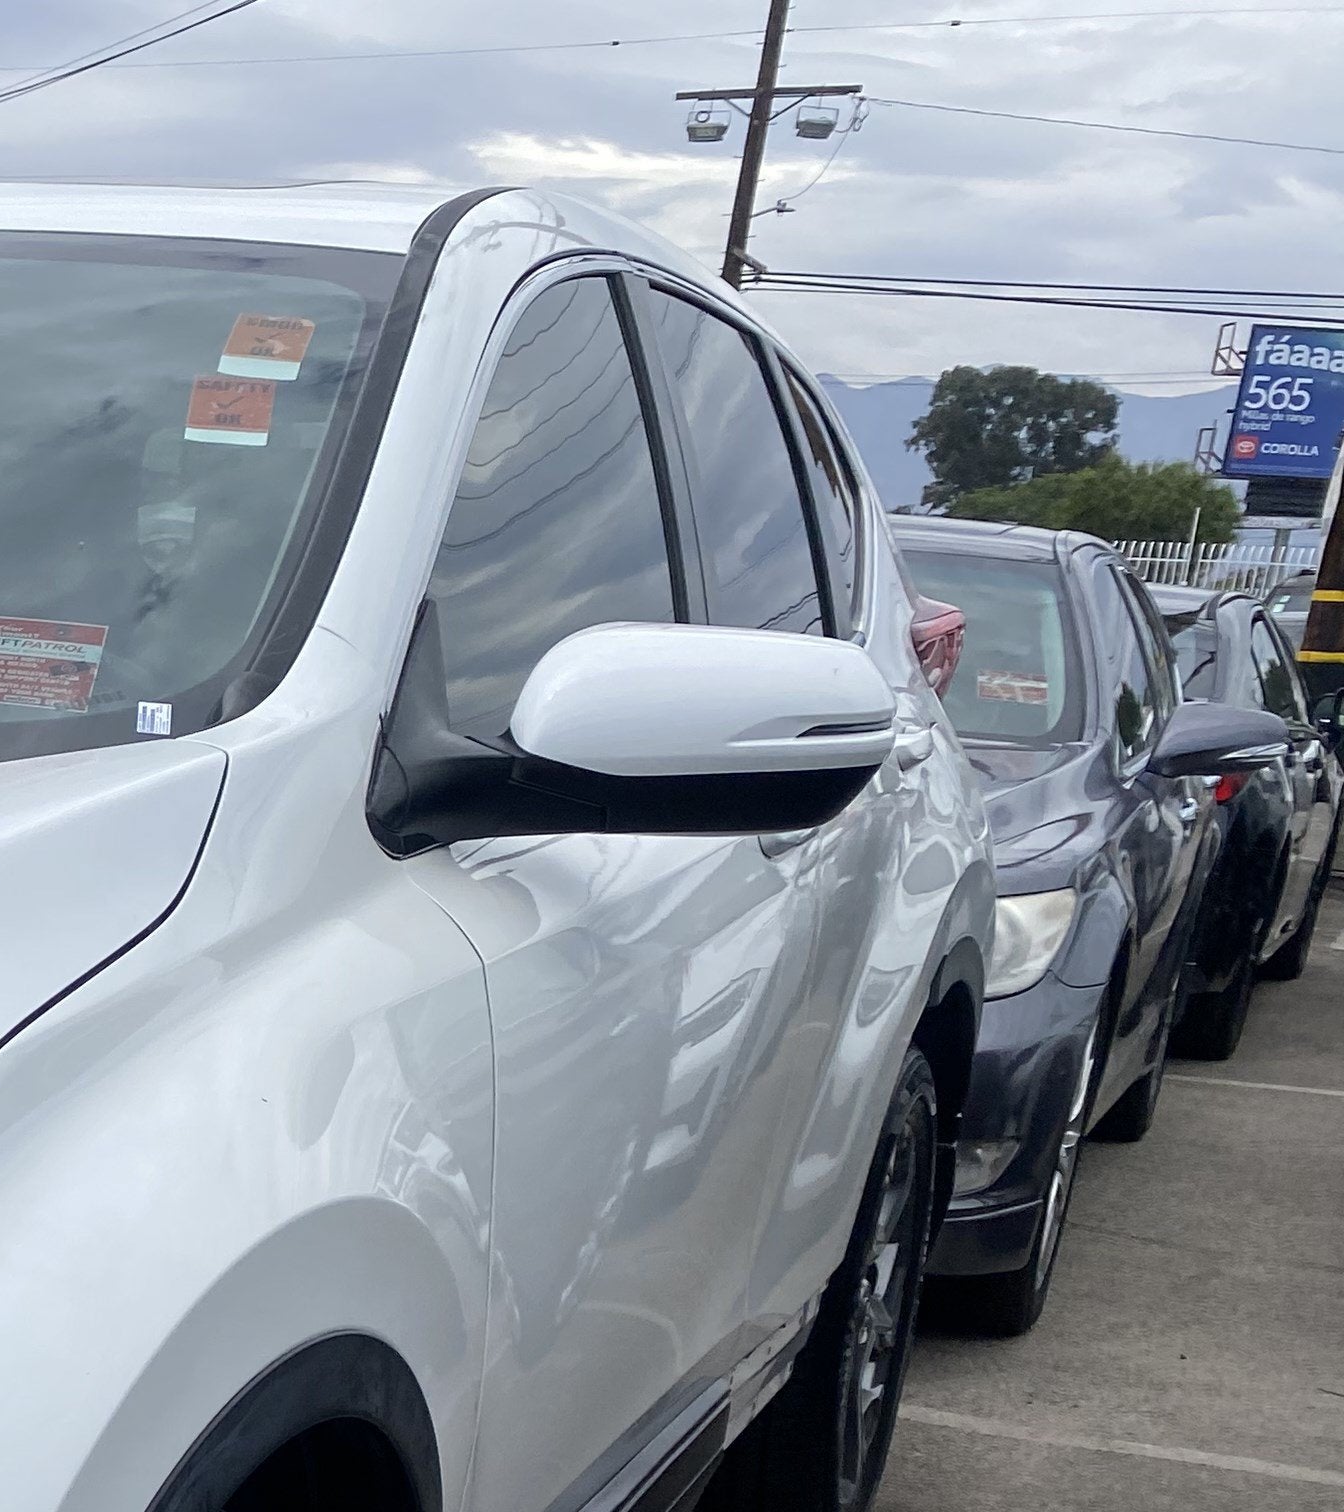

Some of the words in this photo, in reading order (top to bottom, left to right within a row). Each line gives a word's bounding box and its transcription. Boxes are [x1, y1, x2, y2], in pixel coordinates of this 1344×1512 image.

[1244, 375, 1314, 411] 565
[1271, 410, 1284, 421] de
[1286, 413, 1316, 425] rango
[1261, 442, 1320, 456] COROLLA
